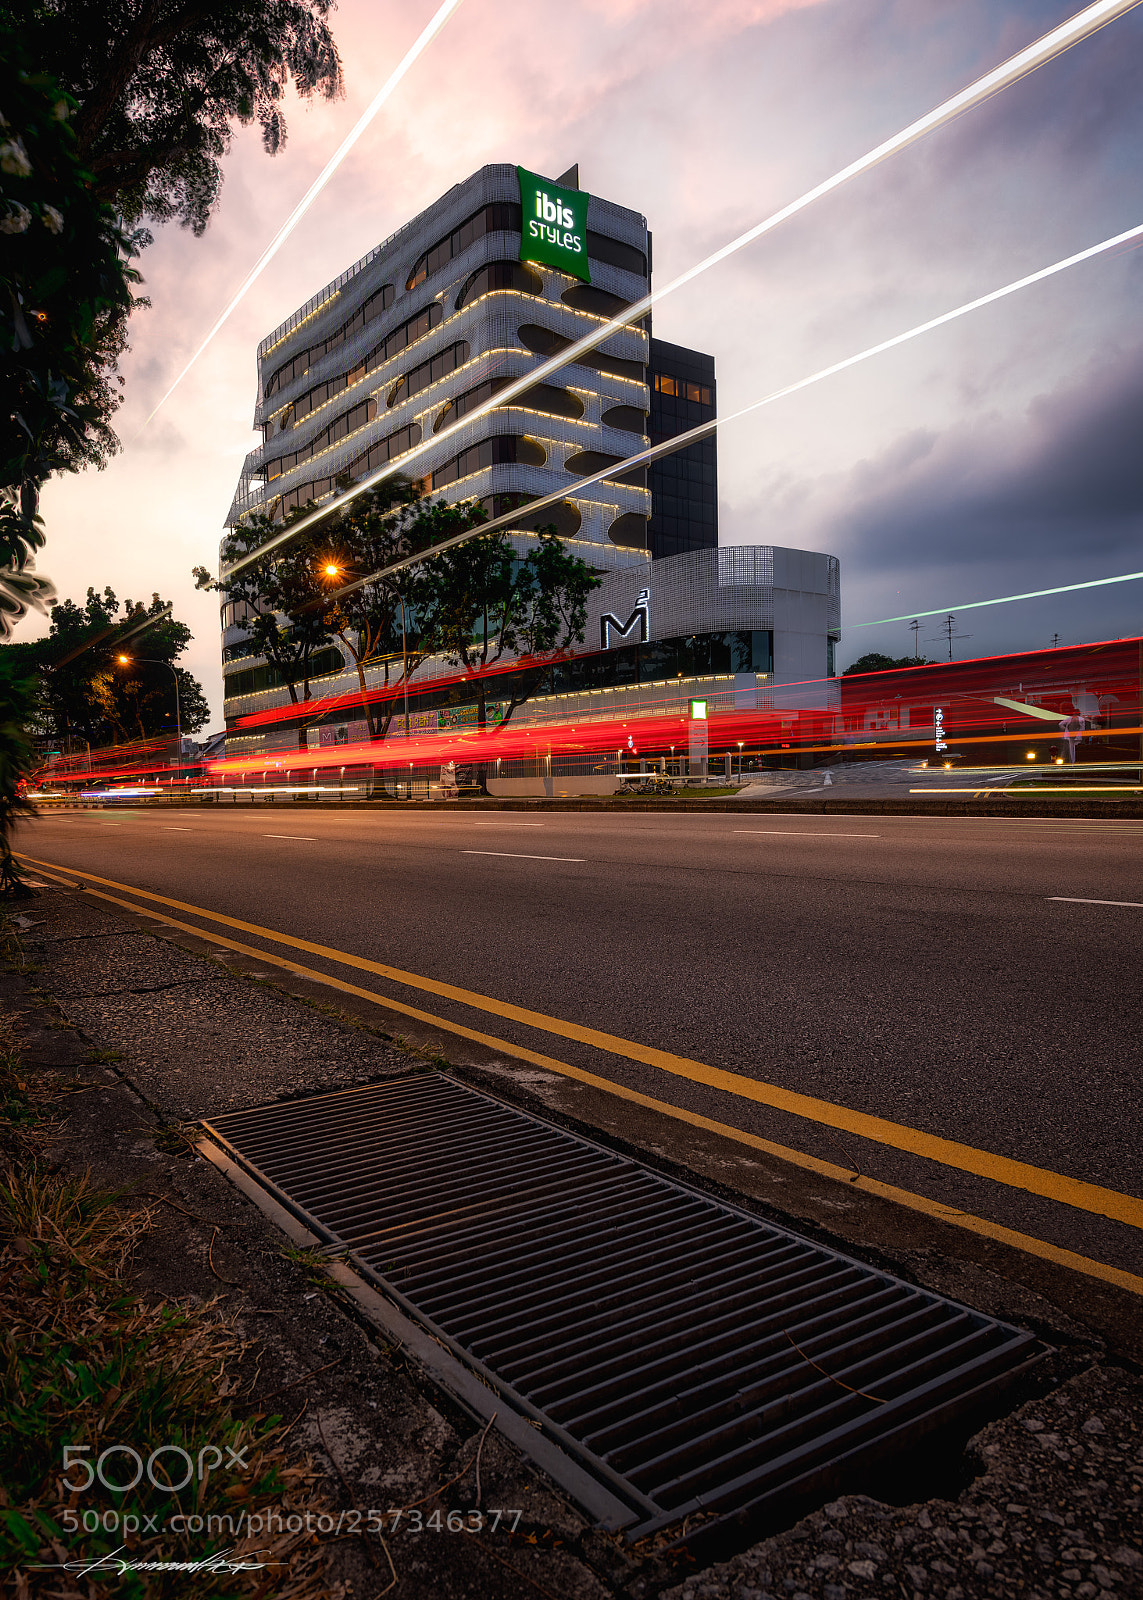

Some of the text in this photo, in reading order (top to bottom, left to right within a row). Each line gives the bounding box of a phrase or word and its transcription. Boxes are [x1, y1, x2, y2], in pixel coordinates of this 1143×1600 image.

[535, 190, 574, 229] ibis
[397, 714, 434, 729] FOR RENT
